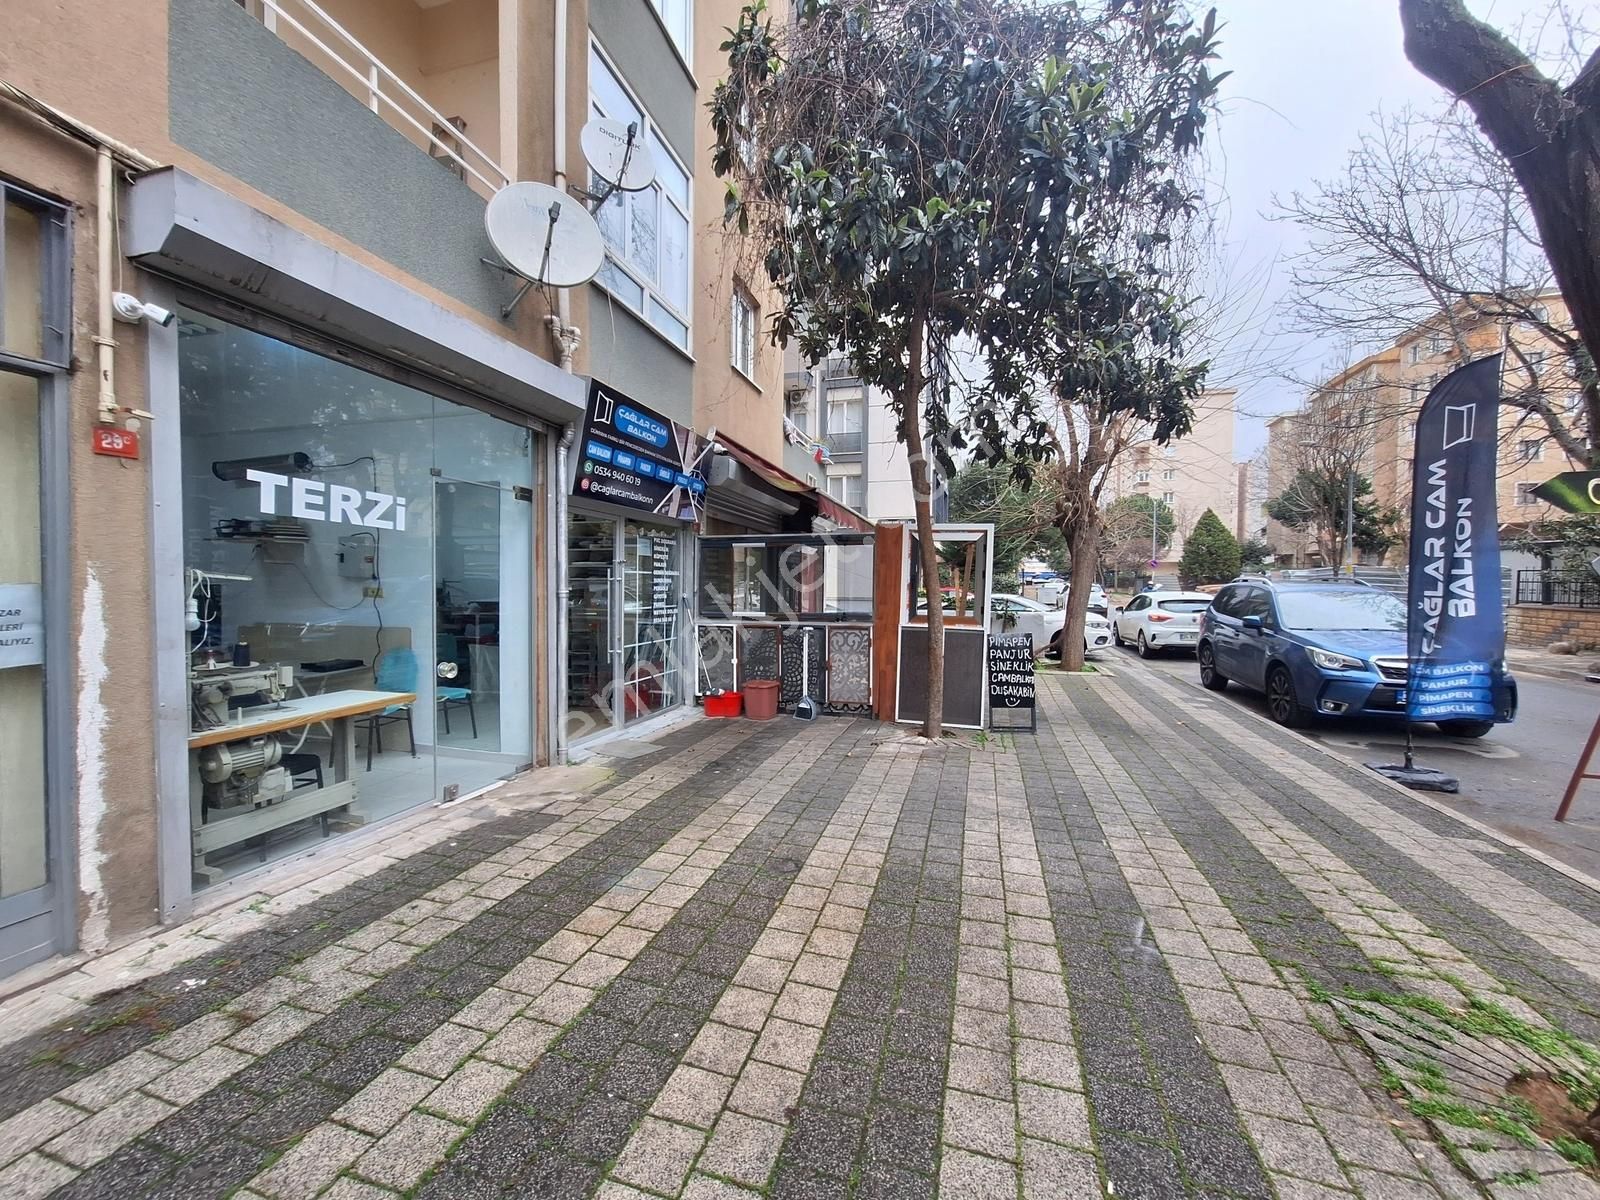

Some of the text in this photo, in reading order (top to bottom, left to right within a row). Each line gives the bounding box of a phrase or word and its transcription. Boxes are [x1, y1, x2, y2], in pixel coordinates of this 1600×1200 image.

[627, 424, 657, 443] BALKON
[650, 424, 667, 436] CAM
[594, 465, 641, 487] 0534 940 60 19
[1417, 458, 1447, 655] ÇAĞLAR CAM
[1448, 497, 1476, 618] BALKON
[990, 649, 1032, 660] PANJUR
[1432, 664, 1484, 676] BALKON
[1421, 678, 1468, 689] PANJUR
[1419, 691, 1473, 702] PİMAPEN
[1421, 703, 1476, 715] SİNEKLİK
